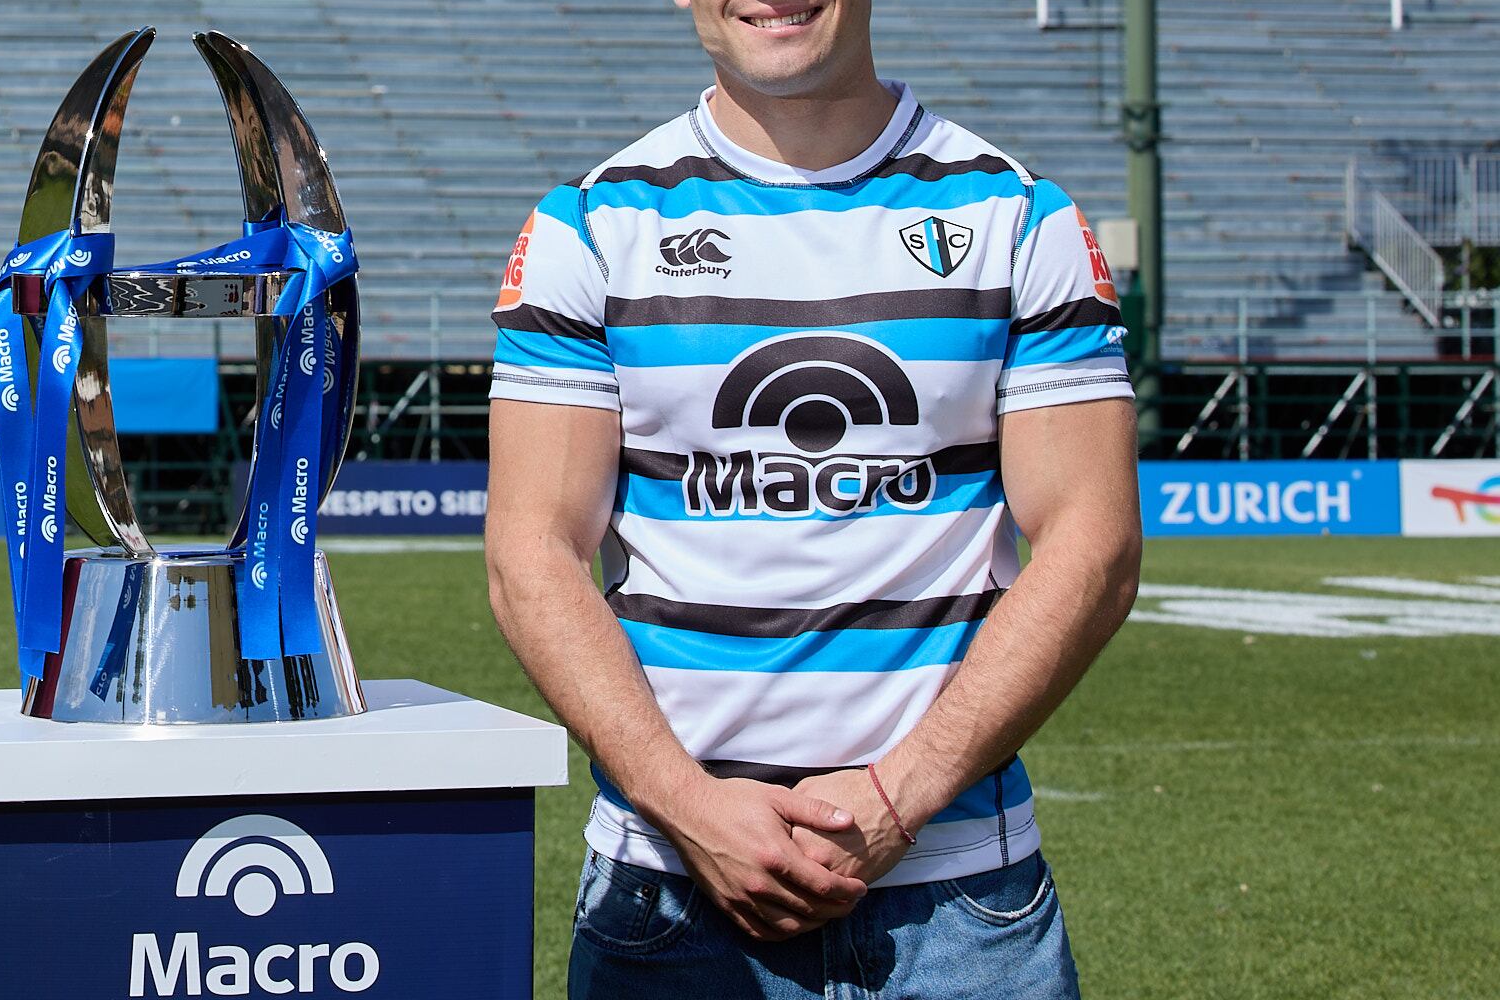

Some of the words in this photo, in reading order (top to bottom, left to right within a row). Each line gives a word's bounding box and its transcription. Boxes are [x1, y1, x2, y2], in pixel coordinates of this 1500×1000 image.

[200, 250, 251, 267] Macro
[655, 264, 732, 279] canterbury
[15, 481, 27, 535] Macro
[43, 455, 58, 512] Macro
[292, 457, 309, 514] Macro
[684, 450, 936, 516] Macro
[1159, 480, 1351, 525] ZURICH
[253, 502, 269, 558] Macro
[129, 932, 380, 998] Macro
